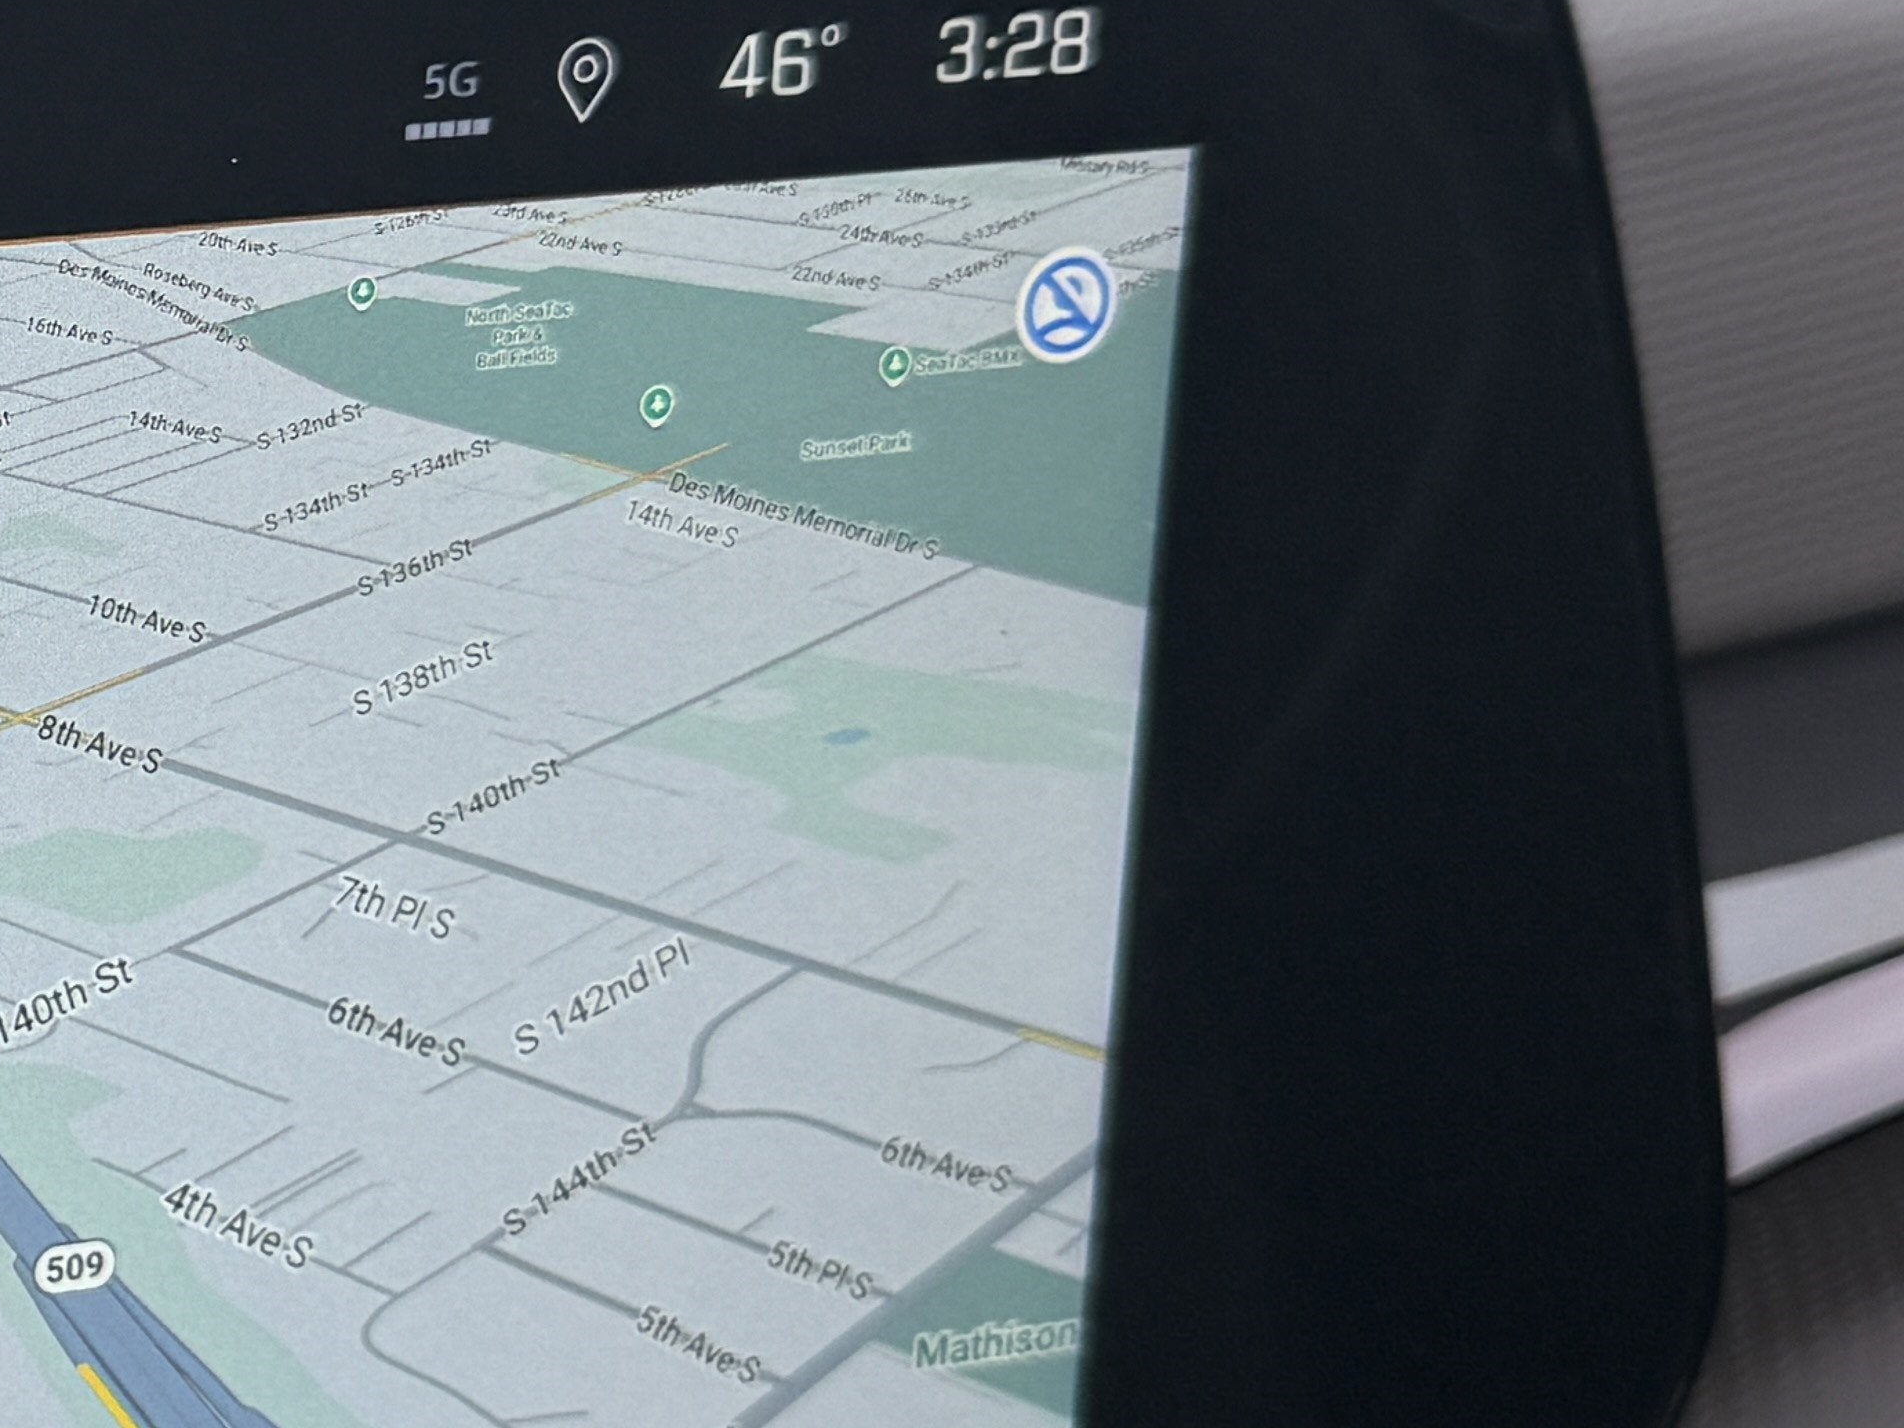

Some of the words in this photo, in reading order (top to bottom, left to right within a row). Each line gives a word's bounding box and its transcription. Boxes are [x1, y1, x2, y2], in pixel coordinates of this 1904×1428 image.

[424, 62, 480, 98] 5G
[721, 22, 845, 98] 46°
[937, 8, 1097, 84] 3:28
[801, 438, 865, 458] Sunset
[868, 433, 910, 453] Park
[628, 500, 672, 532] 14th
[677, 514, 718, 542] Ave
[721, 527, 739, 548] S
[670, 473, 710, 500] Des
[715, 483, 789, 521] Moines
[794, 504, 893, 548] Memorial
[895, 530, 921, 554] Dr
[926, 540, 940, 559] S
[353, 690, 372, 716] S
[380, 655, 458, 702] 138th
[463, 641, 494, 669] St
[38, 714, 82, 749] 8th
[87, 731, 138, 767] Ave
[143, 748, 162, 773] S
[426, 811, 446, 834] S
[452, 776, 527, 823] 140th
[531, 758, 561, 786] St
[336, 877, 386, 921] 7th
[392, 895, 426, 930] Pl
[431, 909, 455, 939] S
[514, 1025, 539, 1054] S
[546, 968, 650, 1039] 142nd
[654, 938, 691, 983] Pl
[503, 1209, 527, 1234] S
[532, 1148, 616, 1215] 144th
[621, 1122, 656, 1154] St
[165, 1185, 218, 1229] 4th
[220, 1211, 282, 1257] Ave
[286, 1237, 314, 1270] S
[47, 1252, 104, 1282] 509
[638, 1306, 686, 1348] 5th
[688, 1332, 738, 1372] Ave
[739, 1357, 761, 1383] S
[916, 1321, 1078, 1368] Mathison
